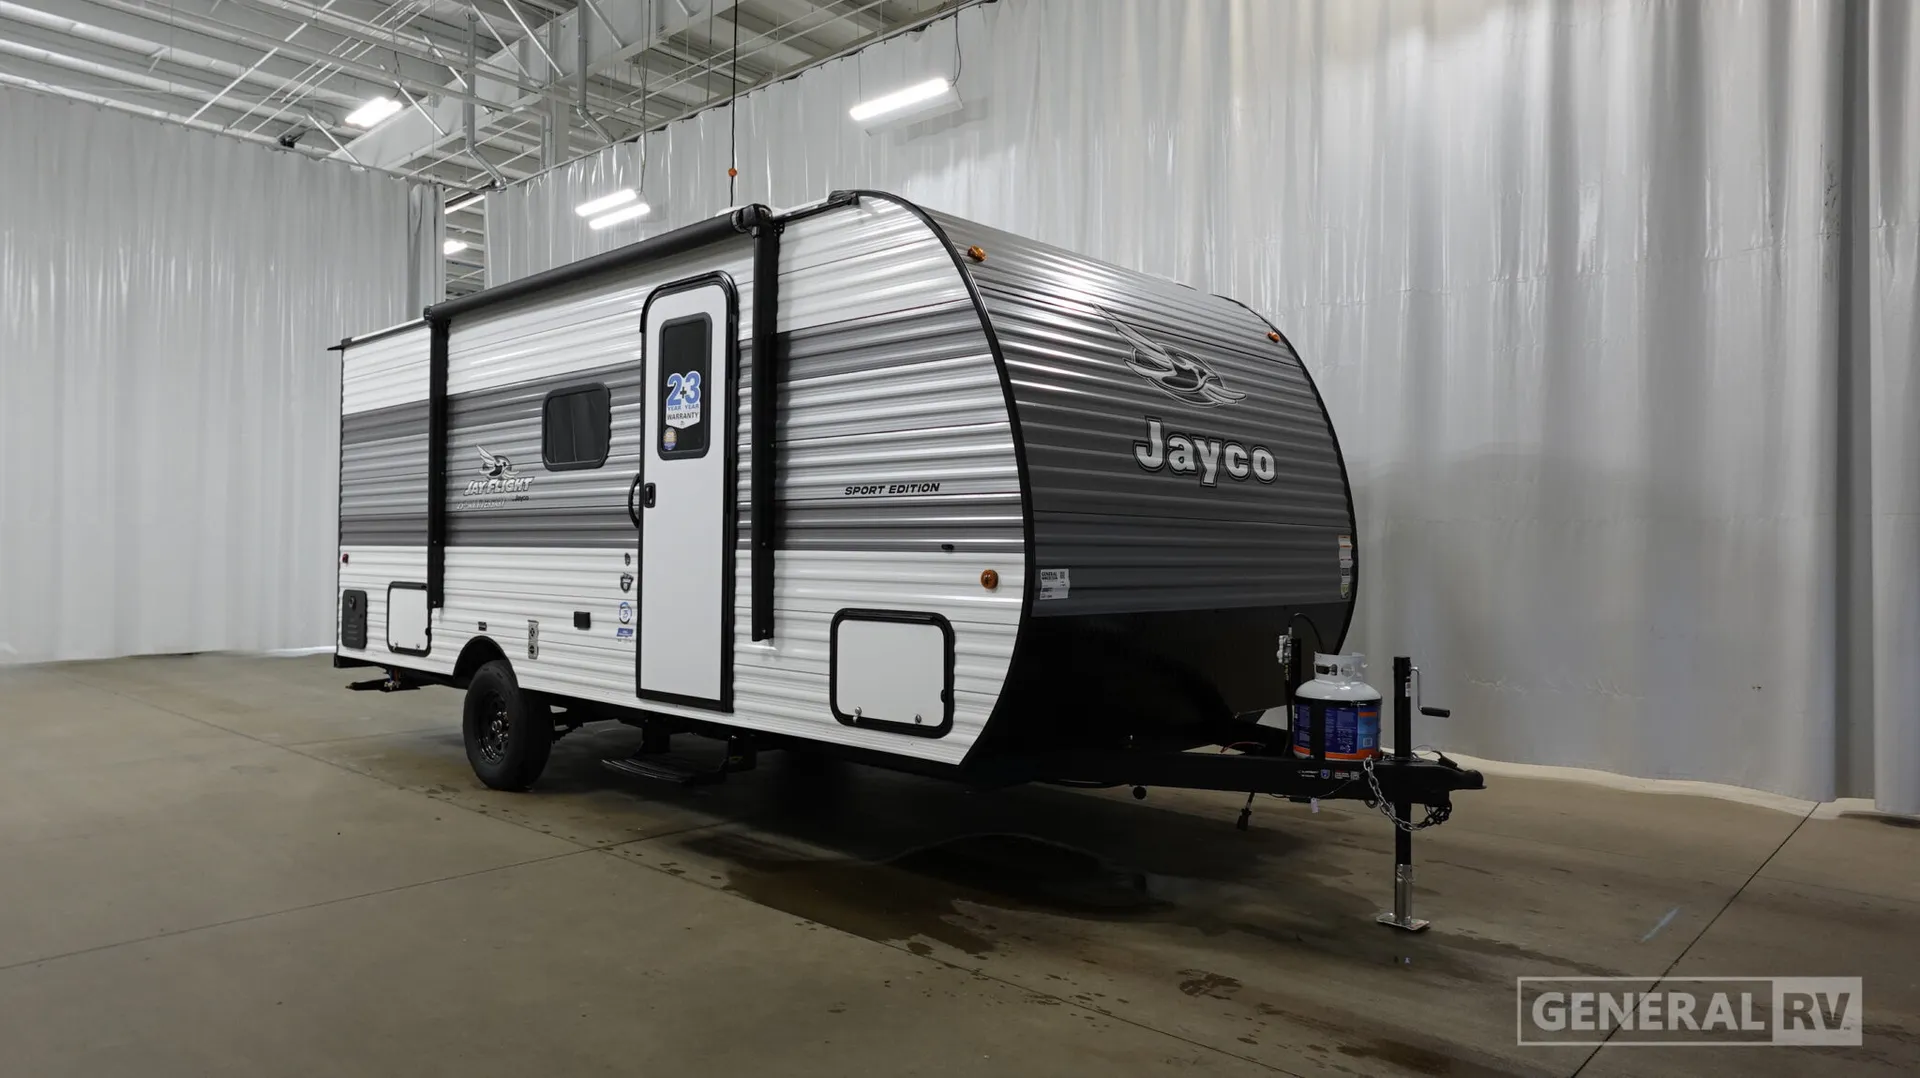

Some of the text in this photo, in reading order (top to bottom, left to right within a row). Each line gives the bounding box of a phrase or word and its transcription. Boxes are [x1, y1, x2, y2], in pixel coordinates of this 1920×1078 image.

[667, 411, 700, 421] WARRANTY
[1134, 416, 1278, 487] Jayco
[463, 476, 535, 497] JAY FLIGHT
[844, 482, 941, 496] SPORT EDITION
